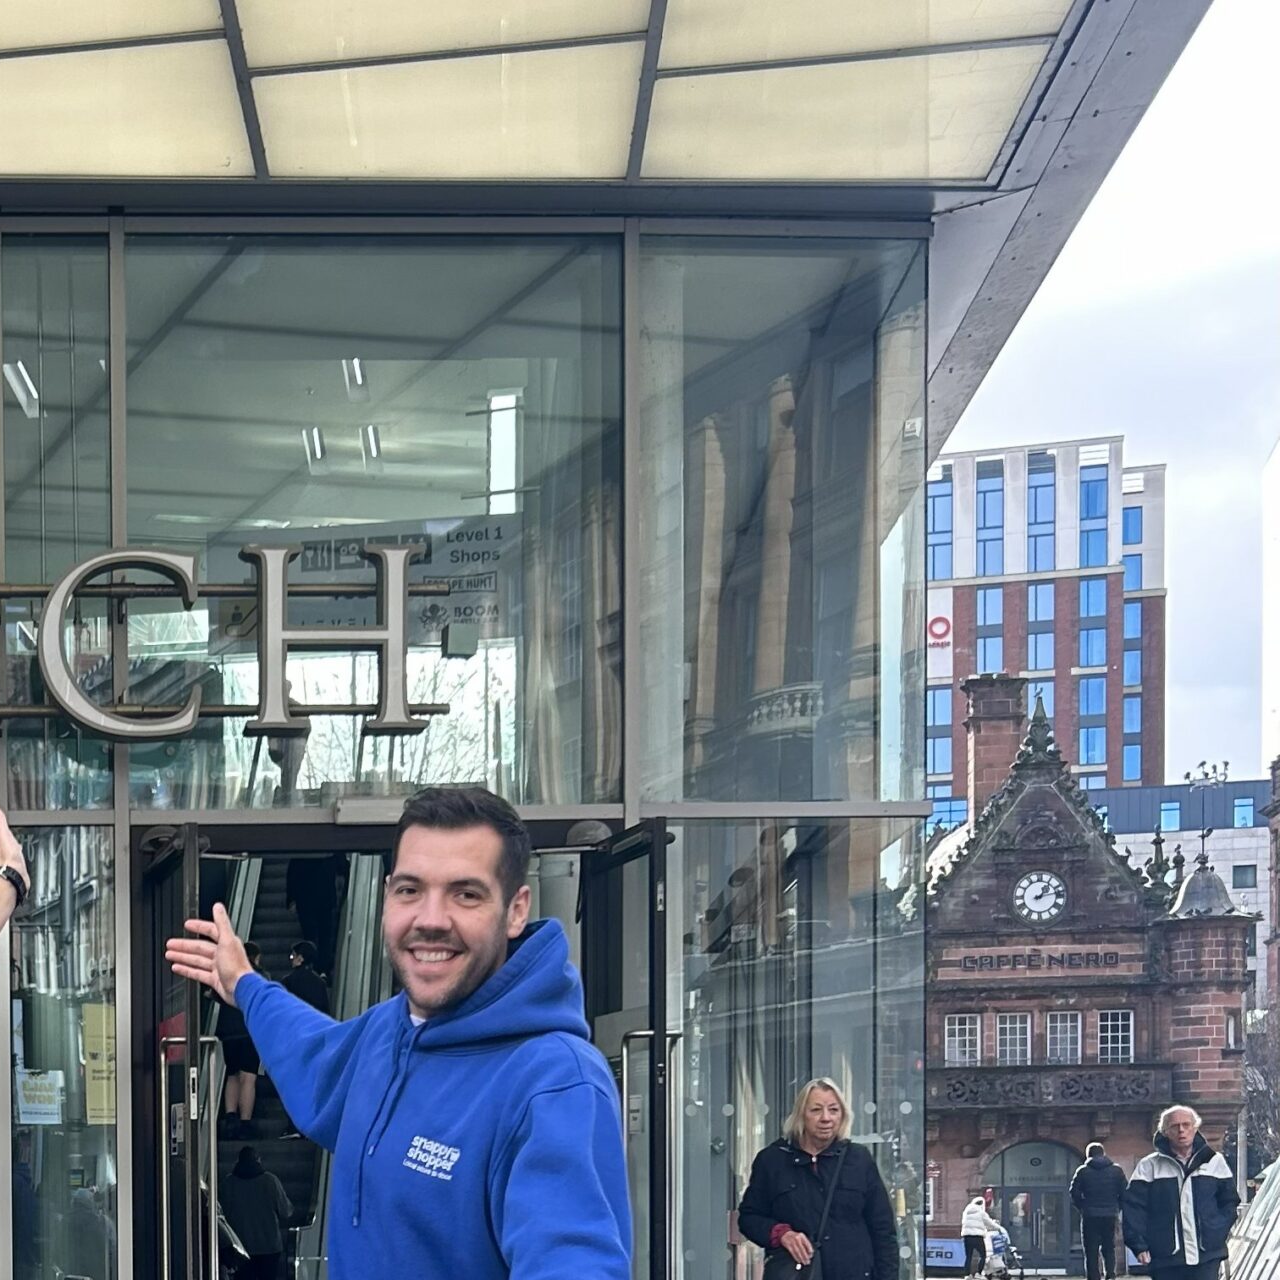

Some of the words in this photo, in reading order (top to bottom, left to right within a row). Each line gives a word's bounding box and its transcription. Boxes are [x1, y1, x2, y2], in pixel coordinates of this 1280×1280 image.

[446, 527, 490, 543] Level
[494, 526, 503, 541] 1
[449, 549, 500, 564] Shops
[466, 576, 493, 589] HUNT
[453, 604, 499, 618] BOOM
[1047, 951, 1120, 969] NERO
[411, 1135, 453, 1160] snappy
[403, 1159, 417, 1169] Local
[406, 1146, 455, 1171] shopper
[926, 1250, 953, 1260] ERO
